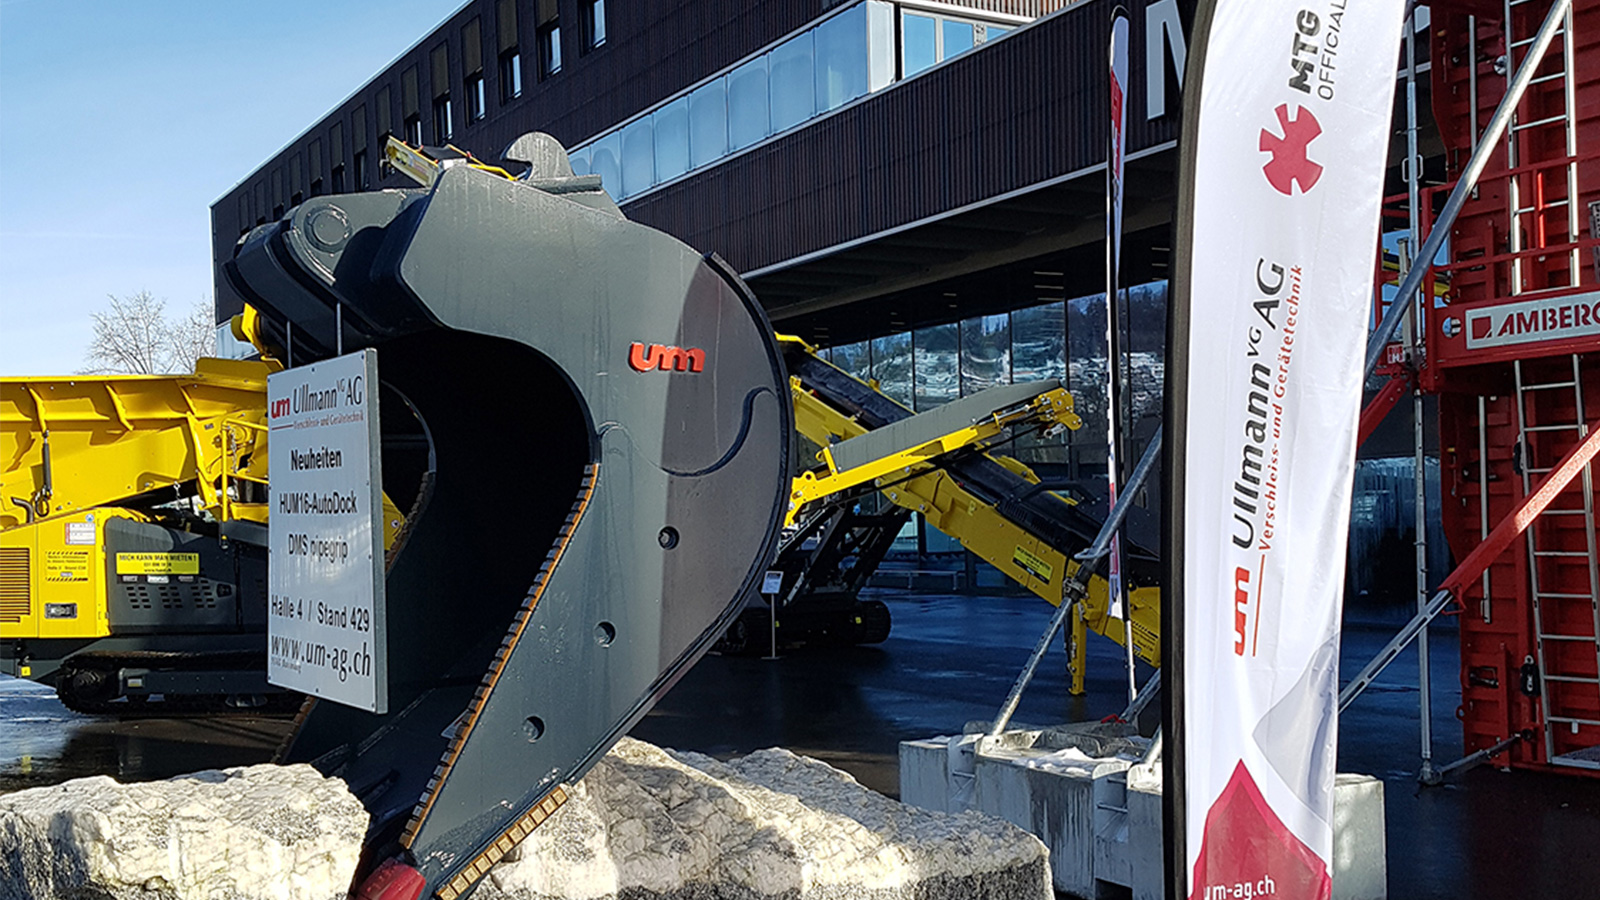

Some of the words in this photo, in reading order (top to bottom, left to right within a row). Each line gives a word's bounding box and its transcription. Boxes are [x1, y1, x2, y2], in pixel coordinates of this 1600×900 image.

[1288, 9, 1321, 94] MTG
[1317, 0, 1348, 101] OFFICIAL
[1253, 257, 1285, 330] AG
[1273, 265, 1302, 398] Gerätetechnik
[629, 341, 706, 373] um
[271, 398, 290, 419] um
[345, 375, 362, 406] AG
[1272, 402, 1283, 439] und
[290, 446, 342, 471] Neuheiten
[1232, 362, 1271, 549] Ullmann
[279, 489, 358, 514] HUM16-AutoDock
[1258, 443, 1280, 550] Verschleiss-
[288, 533, 308, 556] DMS
[310, 535, 348, 564] pipegrip
[271, 594, 294, 619] Halle
[297, 598, 303, 620] 4
[317, 601, 347, 628] Stand
[350, 607, 370, 632] 429
[1234, 566, 1250, 656] um
[271, 634, 371, 682] www.um-ag.ch
